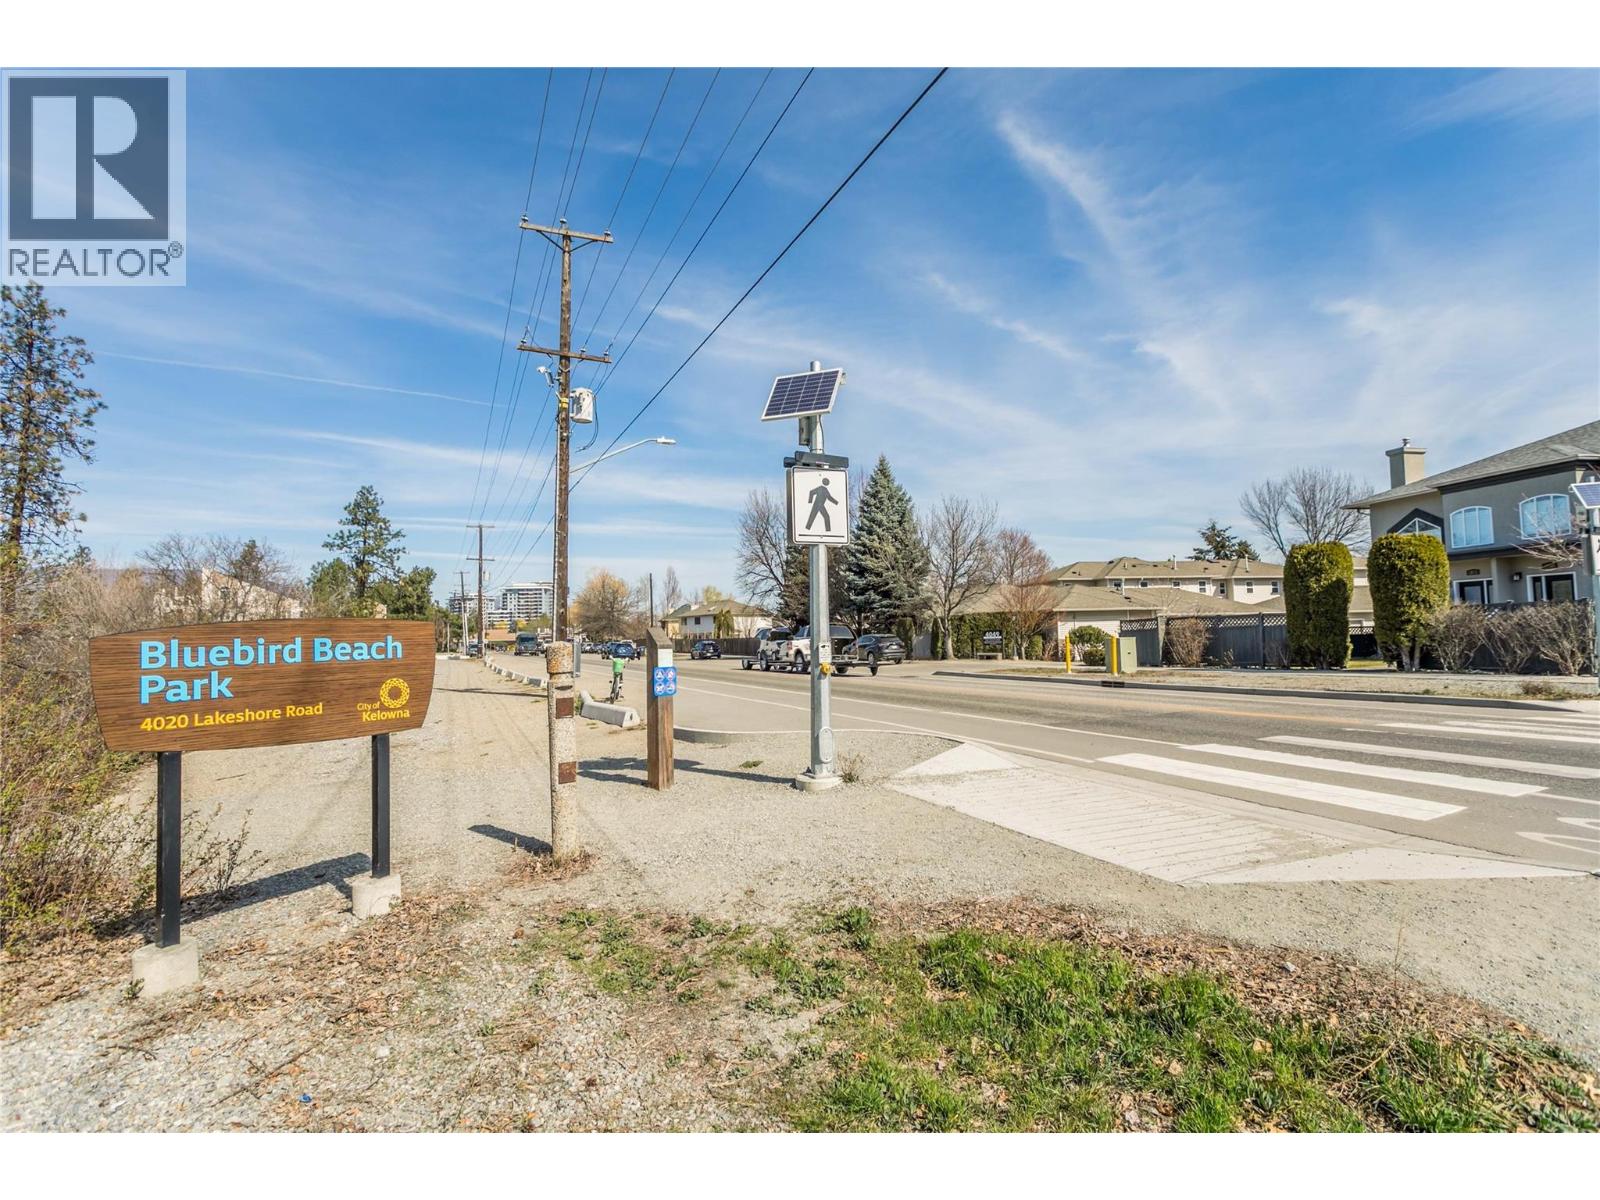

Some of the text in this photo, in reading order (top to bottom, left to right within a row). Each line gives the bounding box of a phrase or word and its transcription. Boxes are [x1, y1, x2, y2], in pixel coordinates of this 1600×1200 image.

[140, 635, 403, 670] Bluebird Beach
[140, 670, 234, 705] Park
[140, 702, 324, 732] 4020 Lakeshore Road
[356, 701, 380, 712] City of
[362, 709, 410, 722] Kelowna
